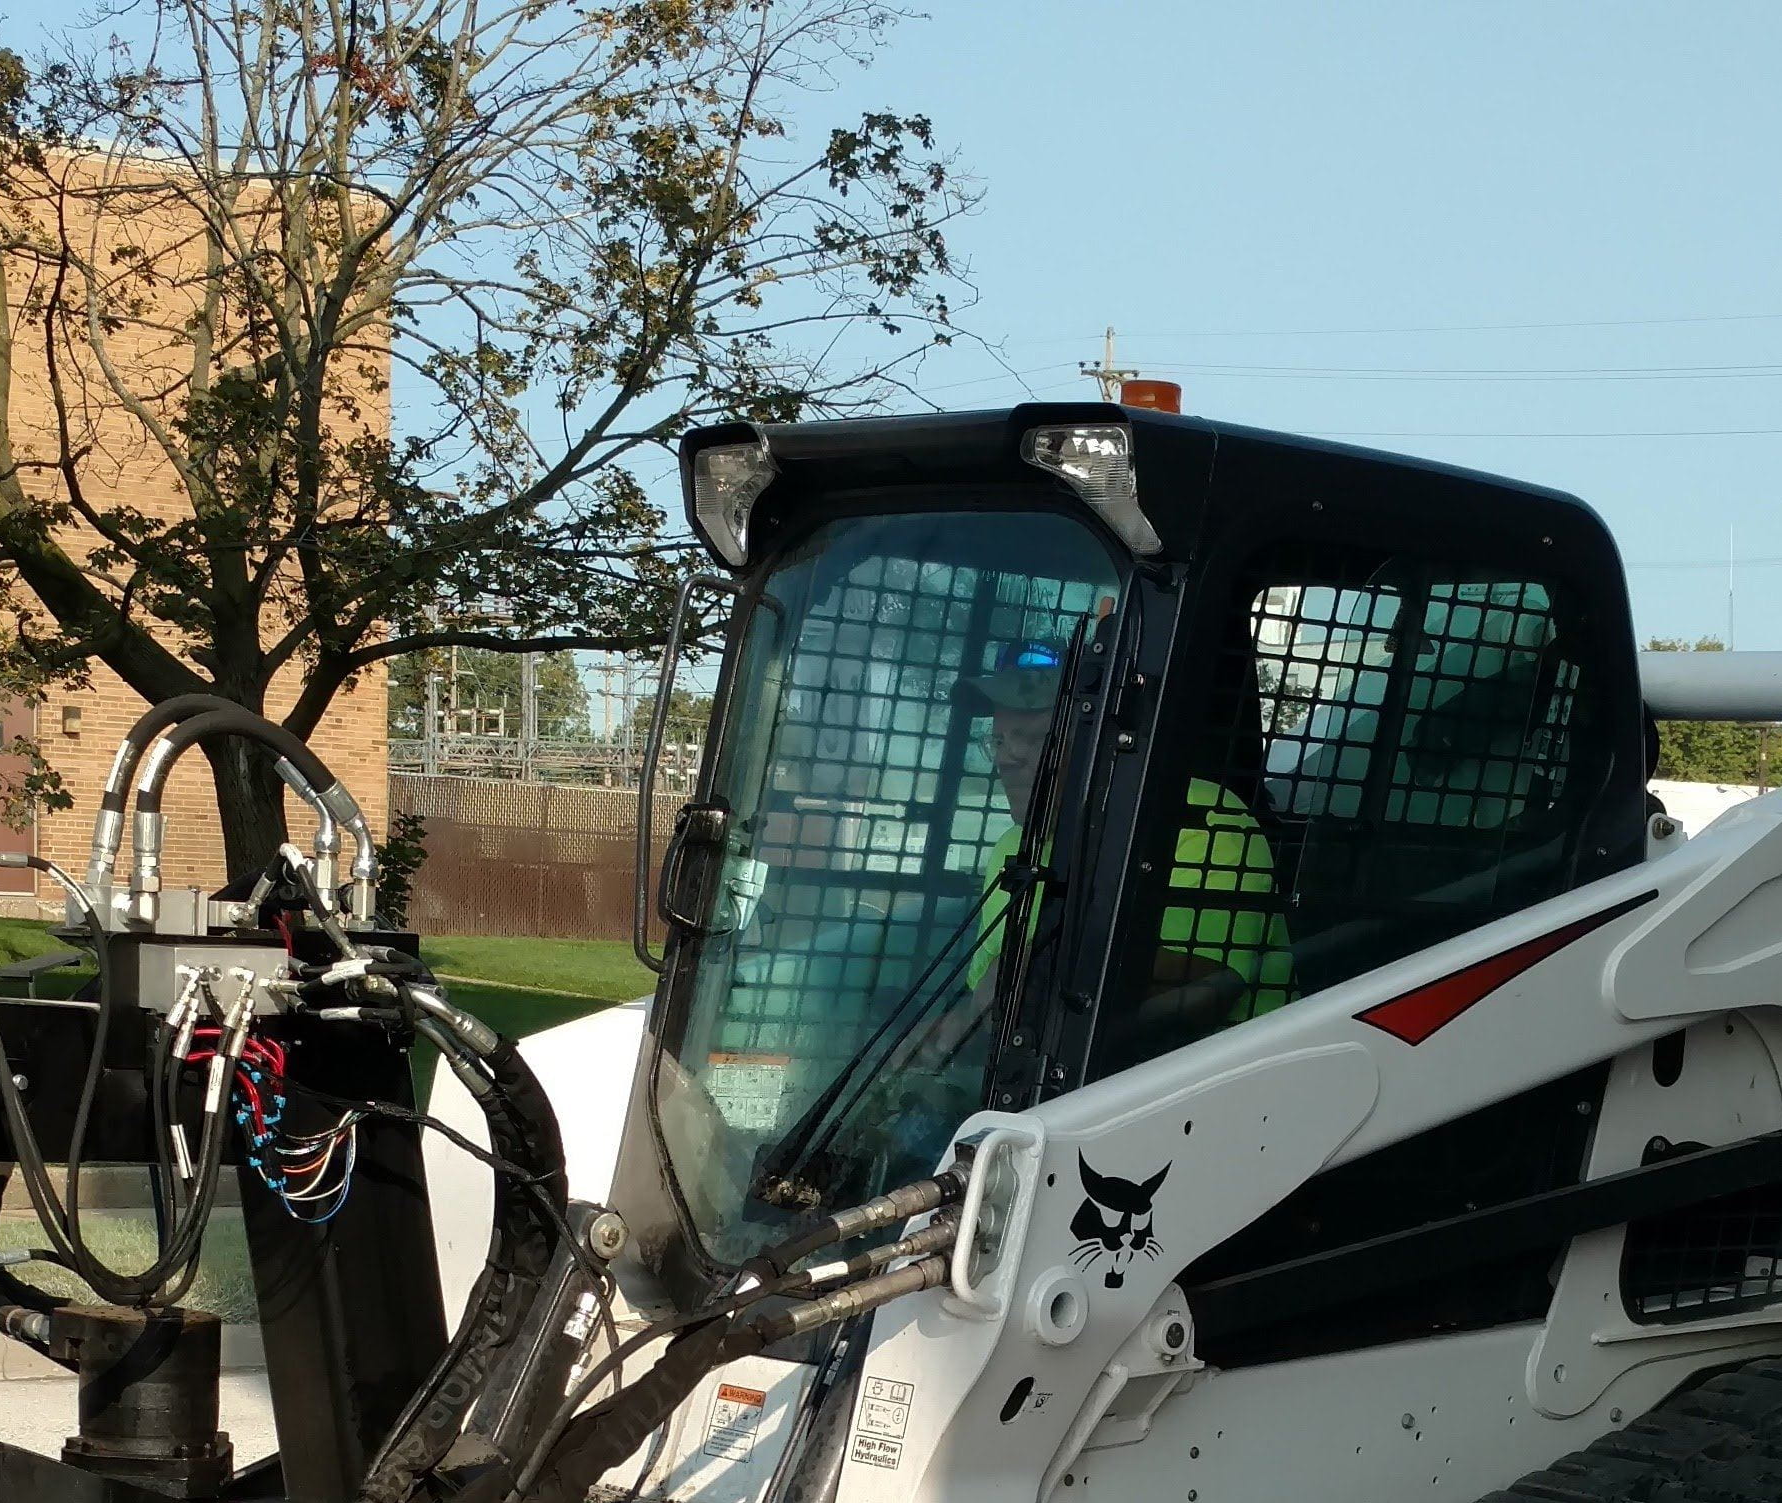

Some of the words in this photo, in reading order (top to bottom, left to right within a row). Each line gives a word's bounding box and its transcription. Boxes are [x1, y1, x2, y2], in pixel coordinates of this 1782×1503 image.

[729, 1388, 762, 1404] WARNING
[858, 1438, 876, 1450] High
[878, 1442, 898, 1453] Flow
[855, 1449, 896, 1465] Hydraulics
